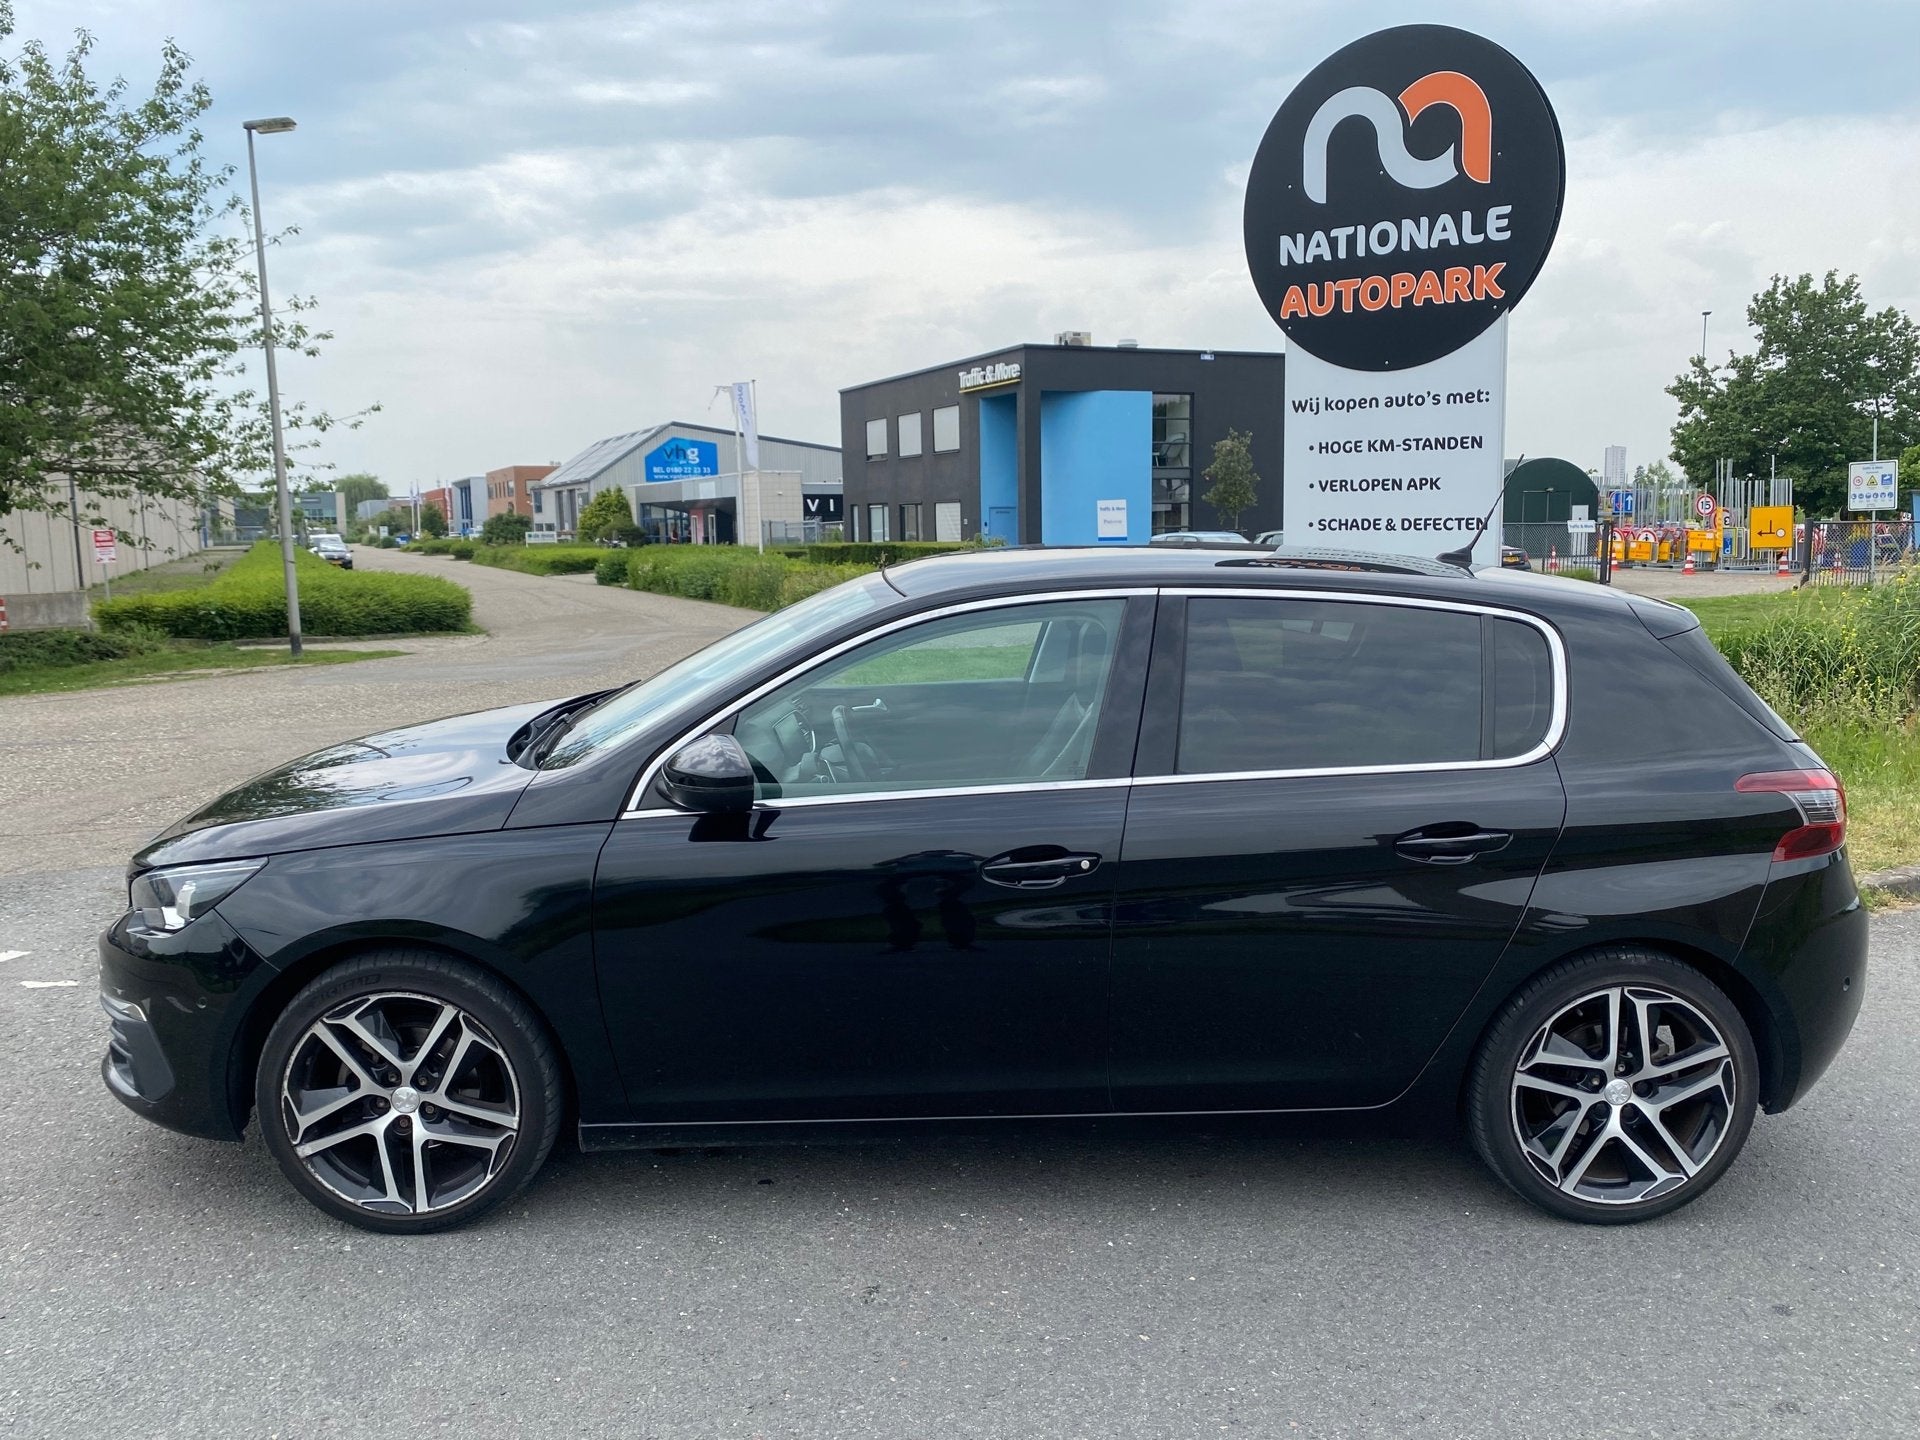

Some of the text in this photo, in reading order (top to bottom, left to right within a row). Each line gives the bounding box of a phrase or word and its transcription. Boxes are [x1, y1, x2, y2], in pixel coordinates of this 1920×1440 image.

[1279, 204, 1513, 267] NATIONALE
[1279, 262, 1507, 320] AUTOPARK
[959, 362, 1021, 388] Traffic & More
[1291, 388, 1490, 415] Wij kopen auto's met:
[663, 444, 700, 464] vhg
[1318, 435, 1483, 454] HOGE KM-STANDEN
[1318, 476, 1442, 492] VERLOPEN APK
[1700, 501, 1711, 510] 15
[1318, 517, 1489, 532] SCHADE & DEFECTEN
